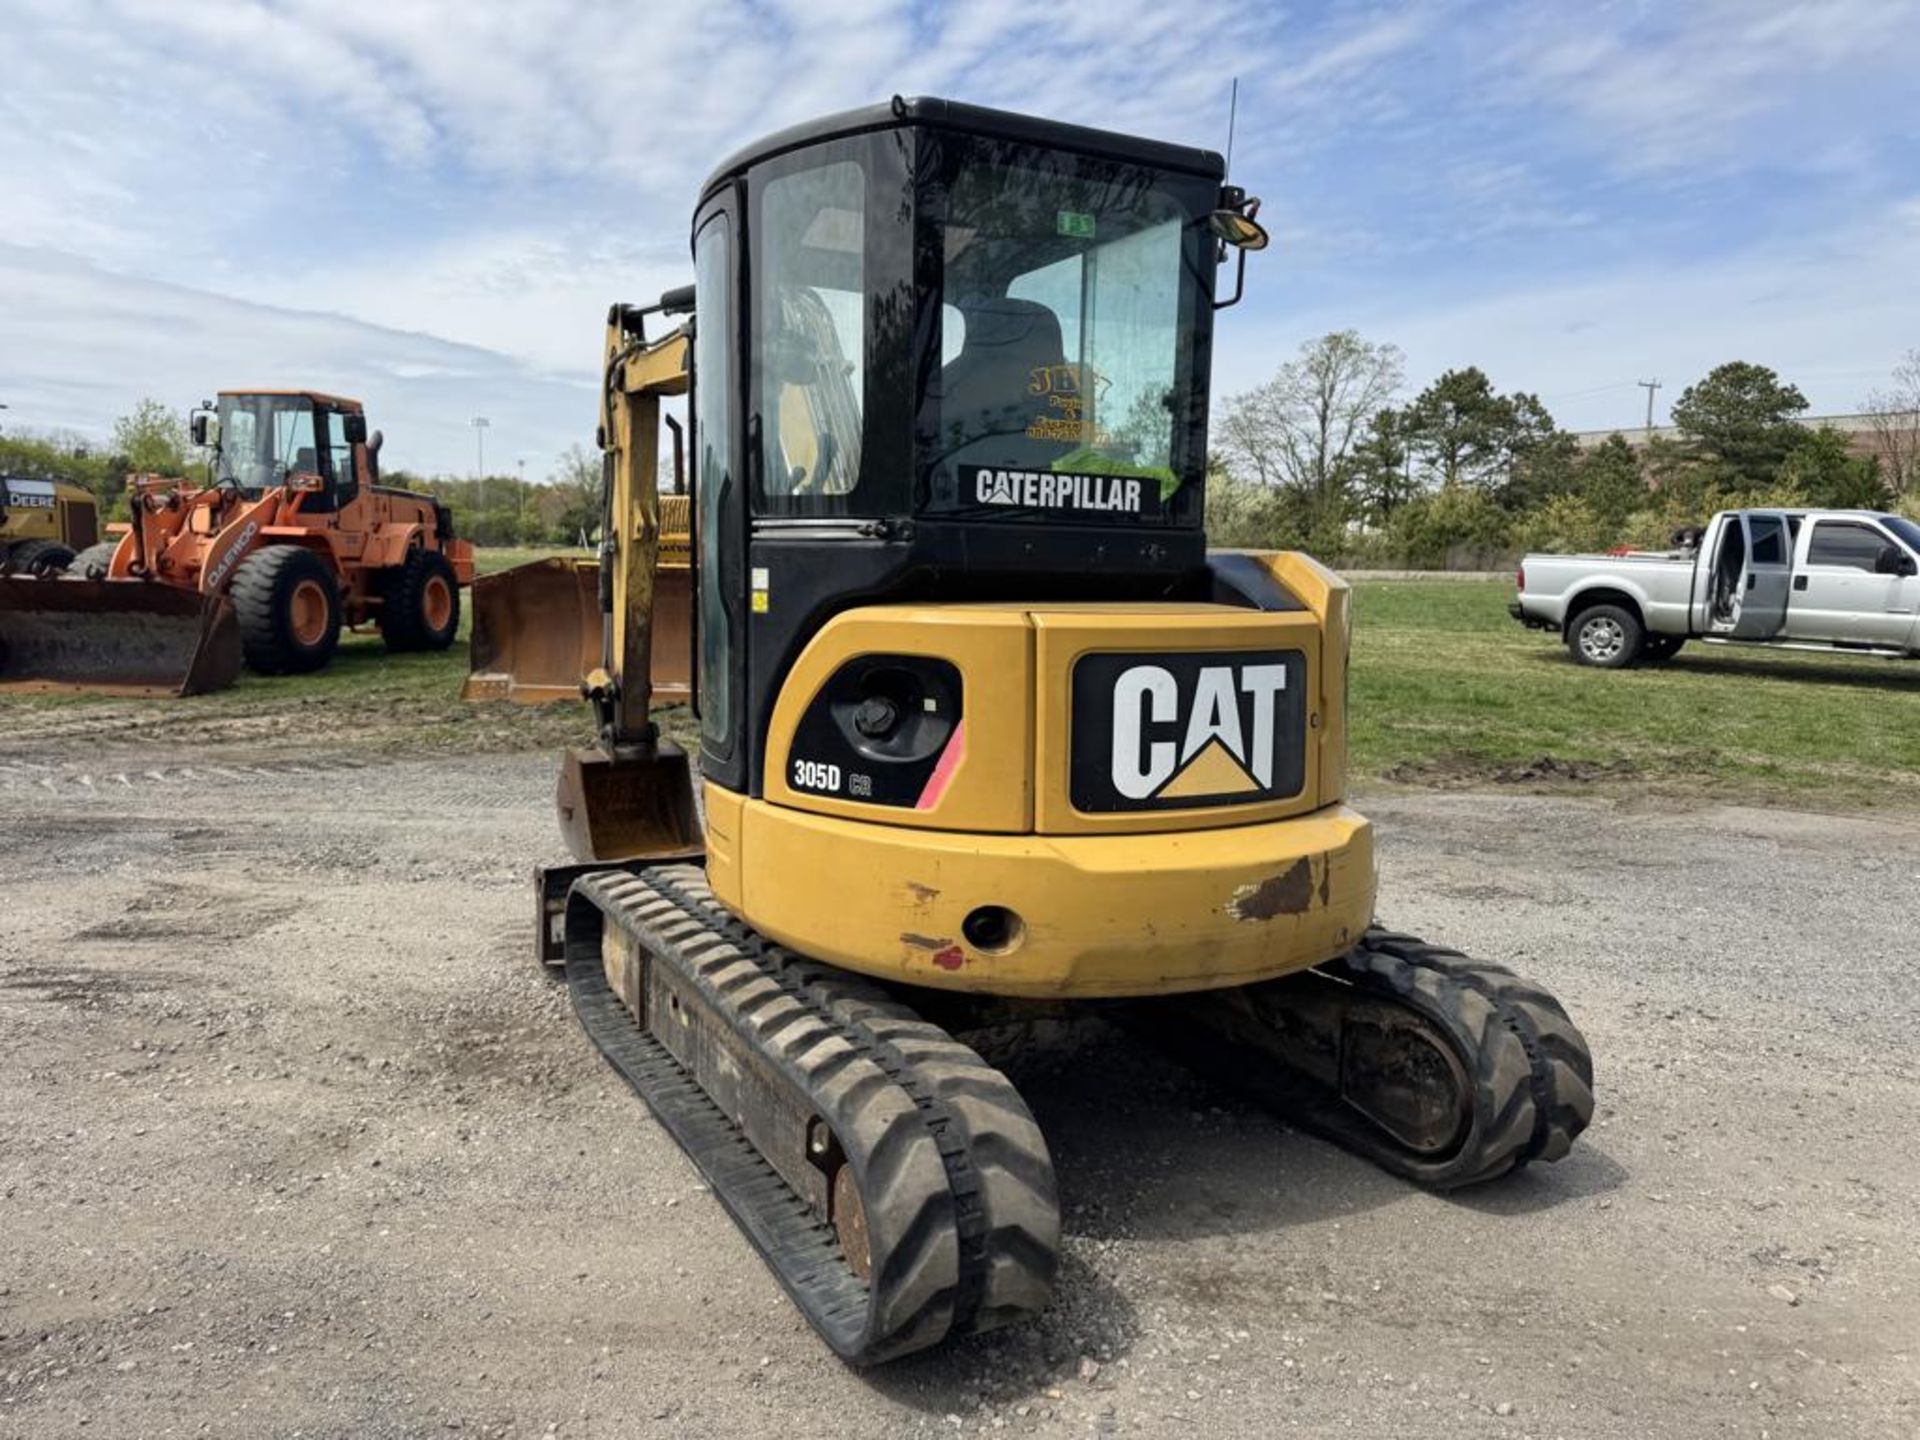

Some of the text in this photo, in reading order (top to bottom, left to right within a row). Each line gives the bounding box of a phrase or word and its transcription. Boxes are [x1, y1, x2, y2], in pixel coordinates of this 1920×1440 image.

[11, 493, 55, 510] DEERE
[976, 469, 1141, 512] CATERPILLAR
[208, 521, 257, 588] DAEWOO
[1111, 664, 1286, 799] CAT
[795, 760, 841, 791] 305D
